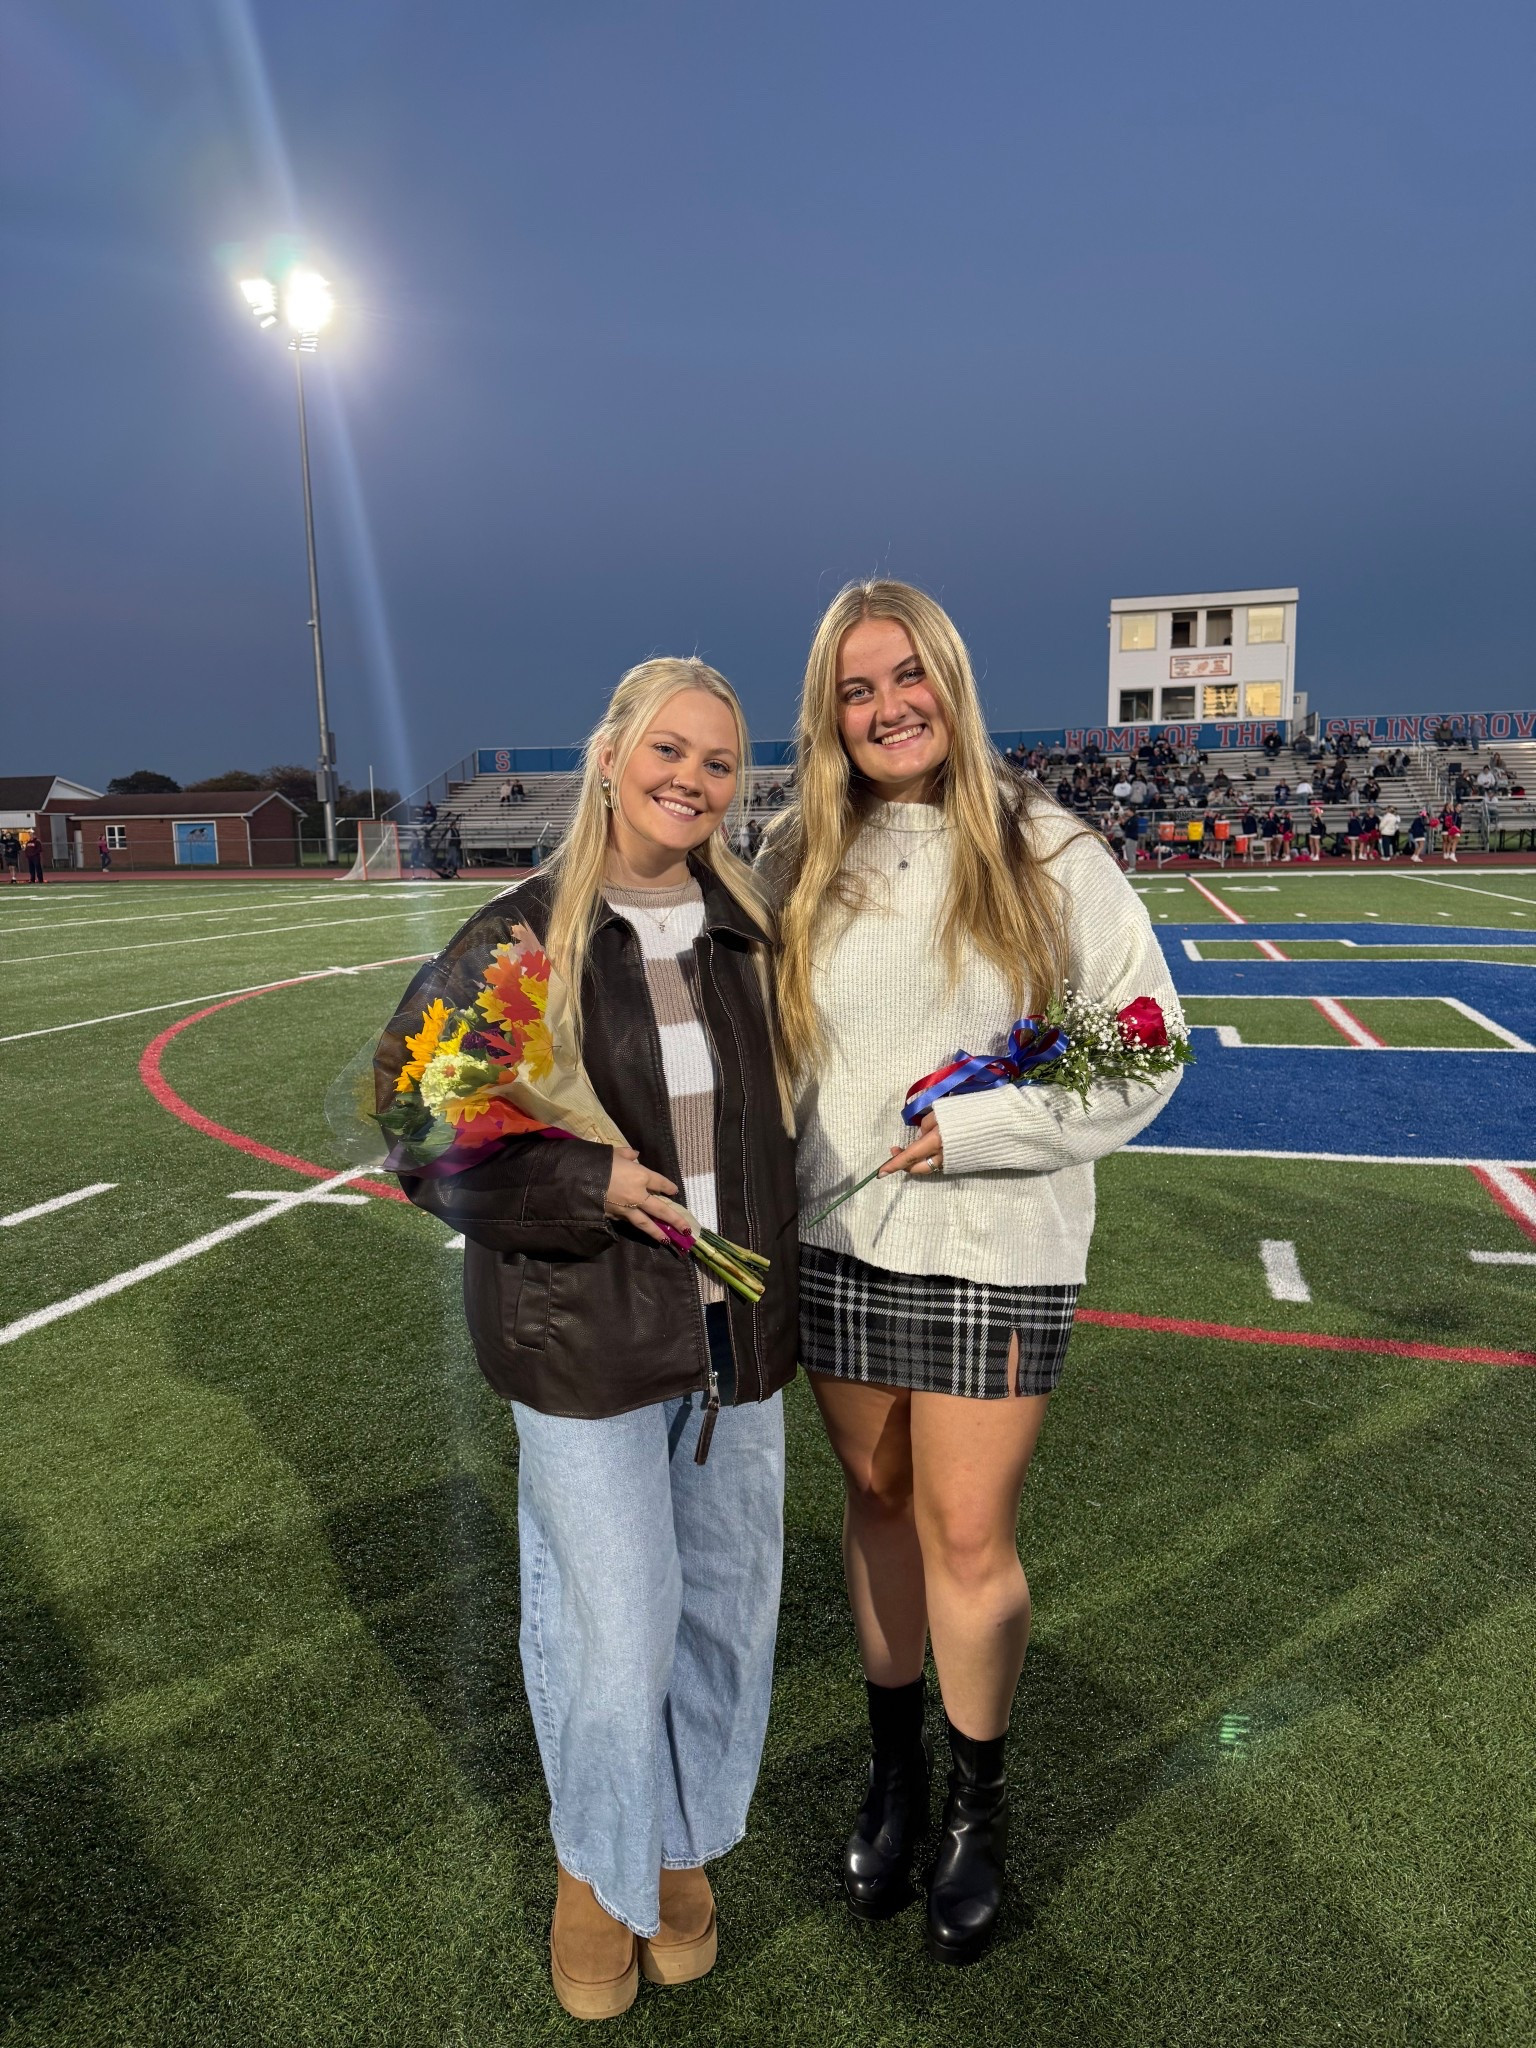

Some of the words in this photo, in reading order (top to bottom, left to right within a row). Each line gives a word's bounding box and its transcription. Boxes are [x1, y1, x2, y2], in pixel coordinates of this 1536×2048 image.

[1065, 727, 1150, 752] HOME
[1164, 725, 1202, 749] OF
[1216, 722, 1277, 747] THE
[496, 751, 510, 772] S
